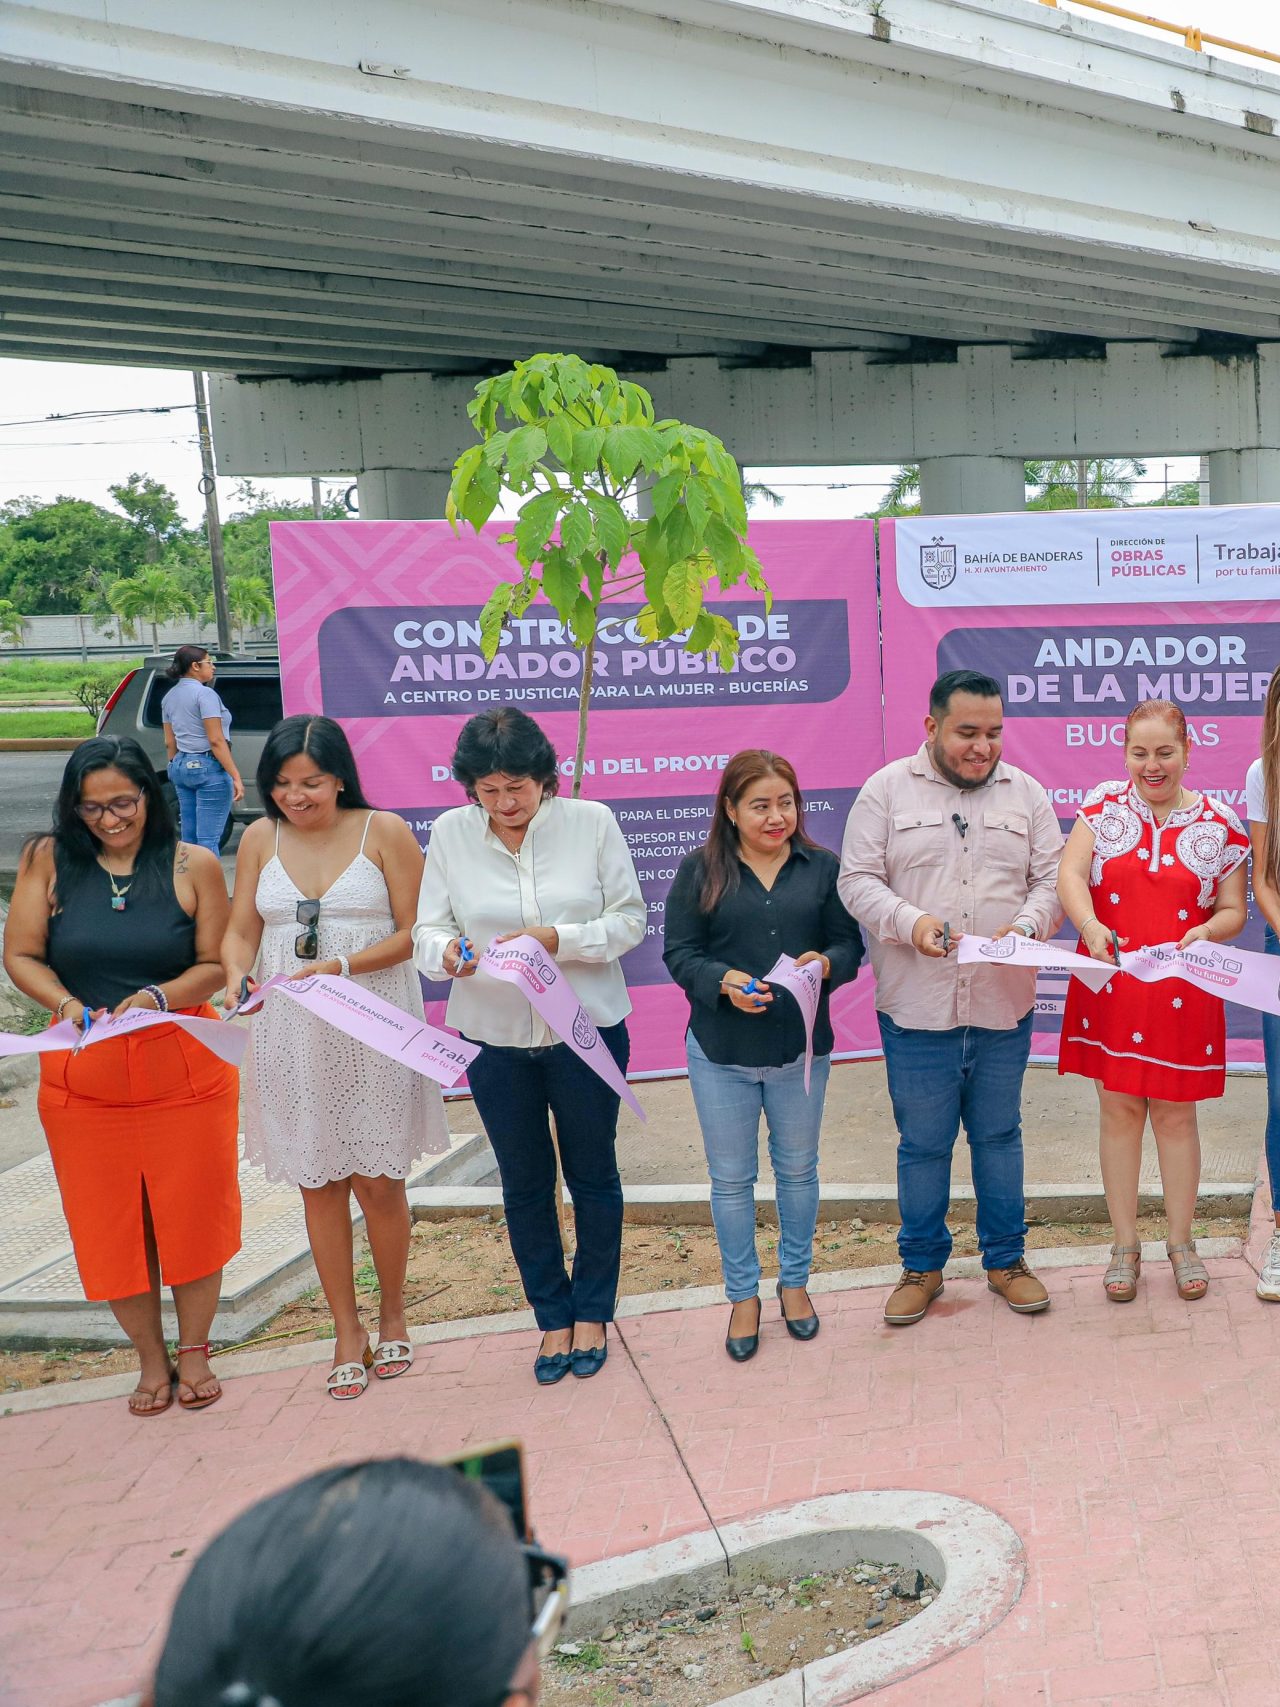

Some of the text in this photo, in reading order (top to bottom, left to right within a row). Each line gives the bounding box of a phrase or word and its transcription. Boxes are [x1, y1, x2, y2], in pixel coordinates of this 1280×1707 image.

[1110, 537, 1166, 547] DIRECCIÓN DE
[964, 551, 1083, 564] BAHÍA DE BANDERAS
[1111, 549, 1163, 562] OBRAS
[974, 566, 982, 574] XI
[984, 565, 1048, 574] AYUNTAMIENTO
[1111, 562, 1186, 577] PÚBLICAS
[1215, 567, 1233, 578] por
[1236, 567, 1248, 576] tu
[737, 614, 790, 641] DE
[1034, 635, 1247, 668] ANDADOR
[390, 650, 609, 682] ANDADOR
[383, 691, 397, 704] A
[401, 689, 472, 704] CENTRO
[477, 688, 500, 702] DE
[505, 687, 577, 701] JUSTICIA
[634, 684, 655, 697] LA
[660, 682, 715, 696] MUJER
[729, 677, 809, 693] BUCERÍAS
[1007, 672, 1273, 703] DE LA MUJER
[1066, 723, 1220, 747] BUCAS
[603, 758, 648, 775] DEL
[654, 754, 730, 772] PROYE
[620, 809, 653, 822] PARA
[656, 809, 671, 820] EL
[679, 831, 696, 841] EN
[629, 847, 687, 858] RRACOTA
[638, 870, 655, 881] EN
[522, 966, 540, 990] futuro
[1203, 970, 1230, 984] futuro
[320, 983, 405, 1031] BAHÍA DE BANDERAS
[421, 1052, 438, 1062] por
[439, 1060, 449, 1069] tu
